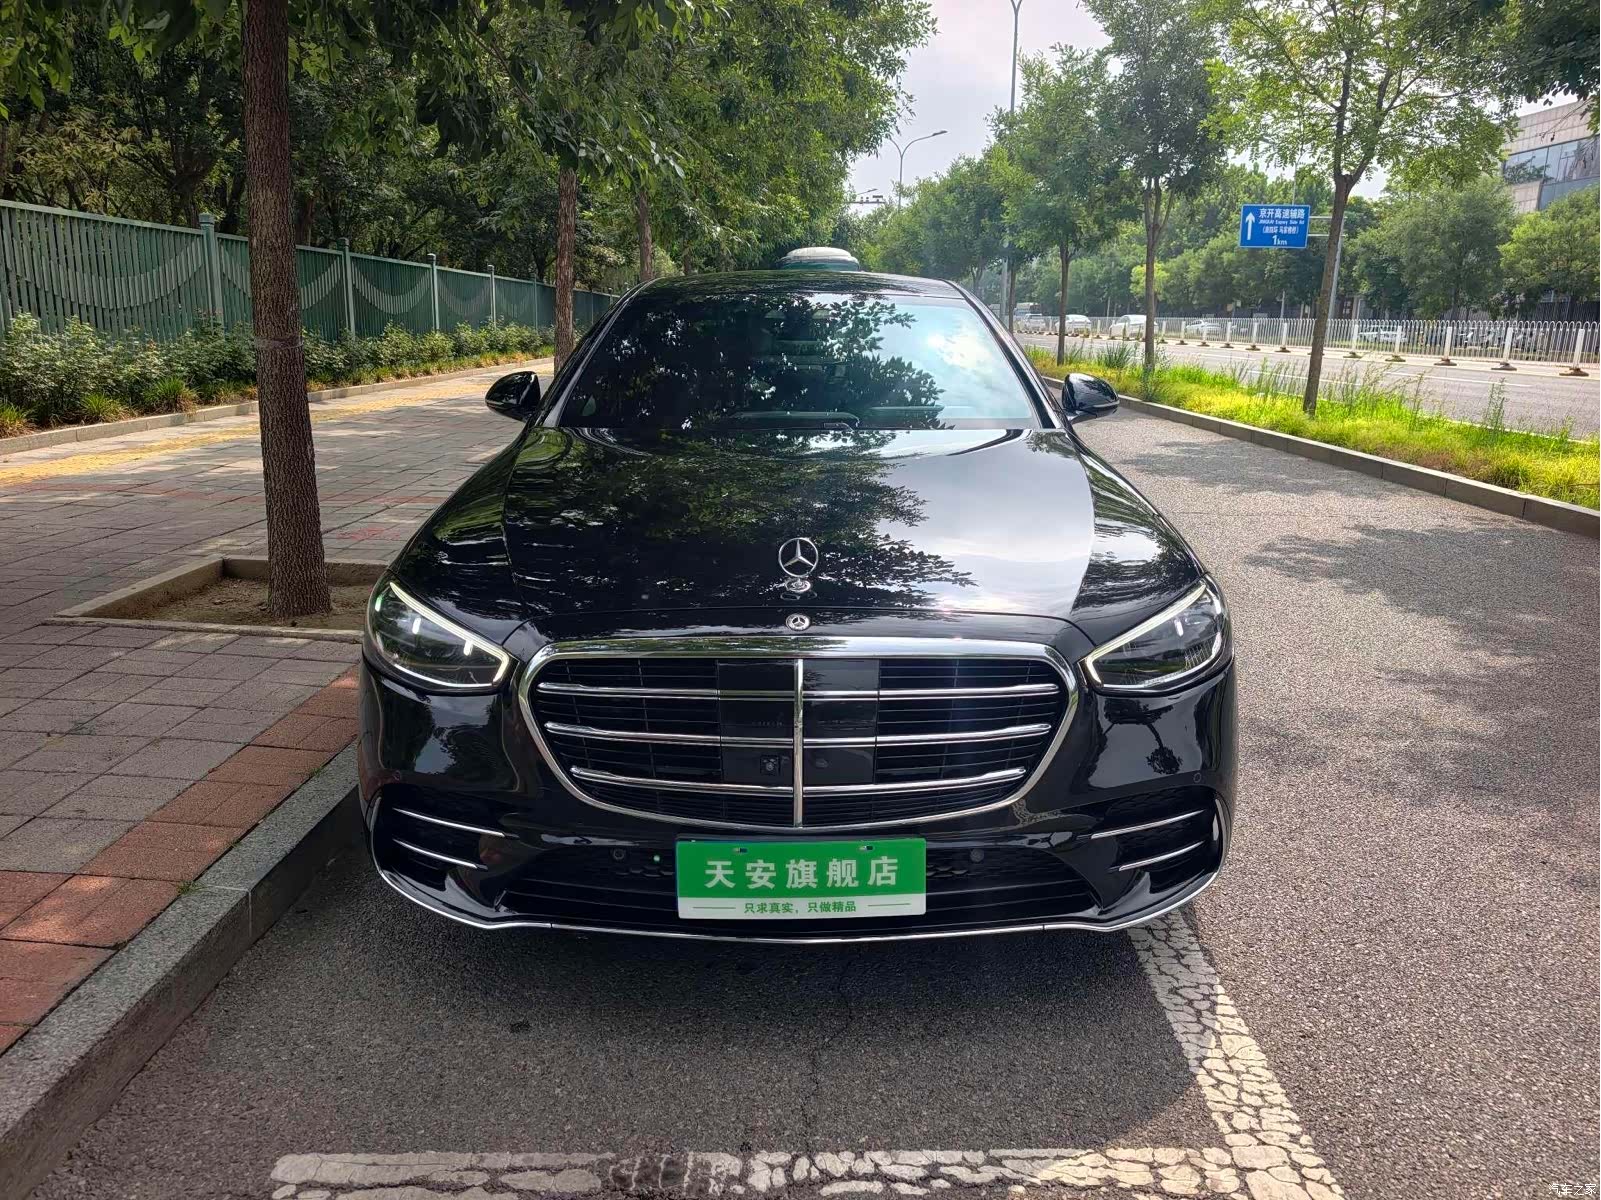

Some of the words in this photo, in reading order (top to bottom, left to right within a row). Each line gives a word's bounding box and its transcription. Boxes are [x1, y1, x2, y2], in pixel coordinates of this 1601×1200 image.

[1259, 208, 1305, 219] 京开高速辅路
[704, 855, 899, 890] 天安旗舰店
[744, 901, 857, 915] 只求真实，只做精品
